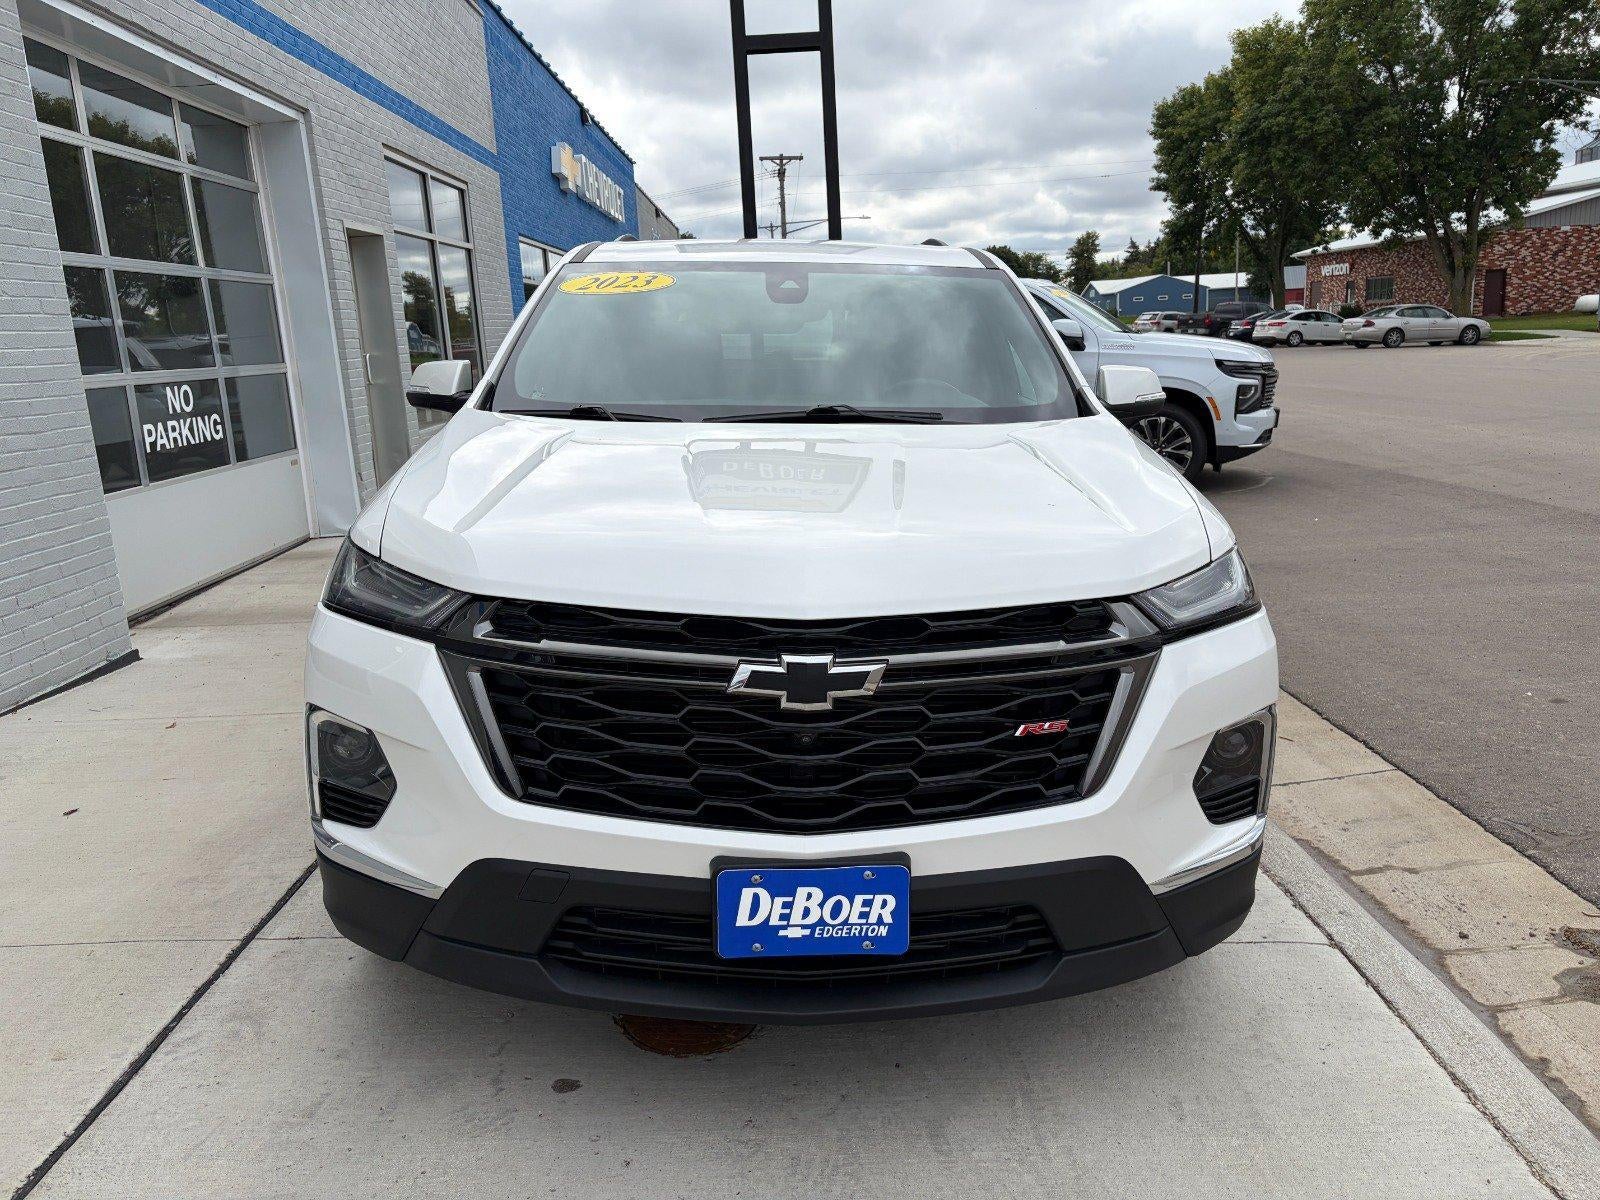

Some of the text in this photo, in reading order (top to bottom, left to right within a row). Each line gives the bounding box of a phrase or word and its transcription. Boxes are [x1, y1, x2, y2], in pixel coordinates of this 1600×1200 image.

[1321, 262, 1350, 277] verizon
[574, 276, 659, 291] 2023
[165, 384, 194, 414] NO
[142, 413, 224, 454] PARKING
[1014, 719, 1070, 737] RS
[735, 886, 897, 927] DEBOER
[814, 925, 889, 938] EDGERTON
